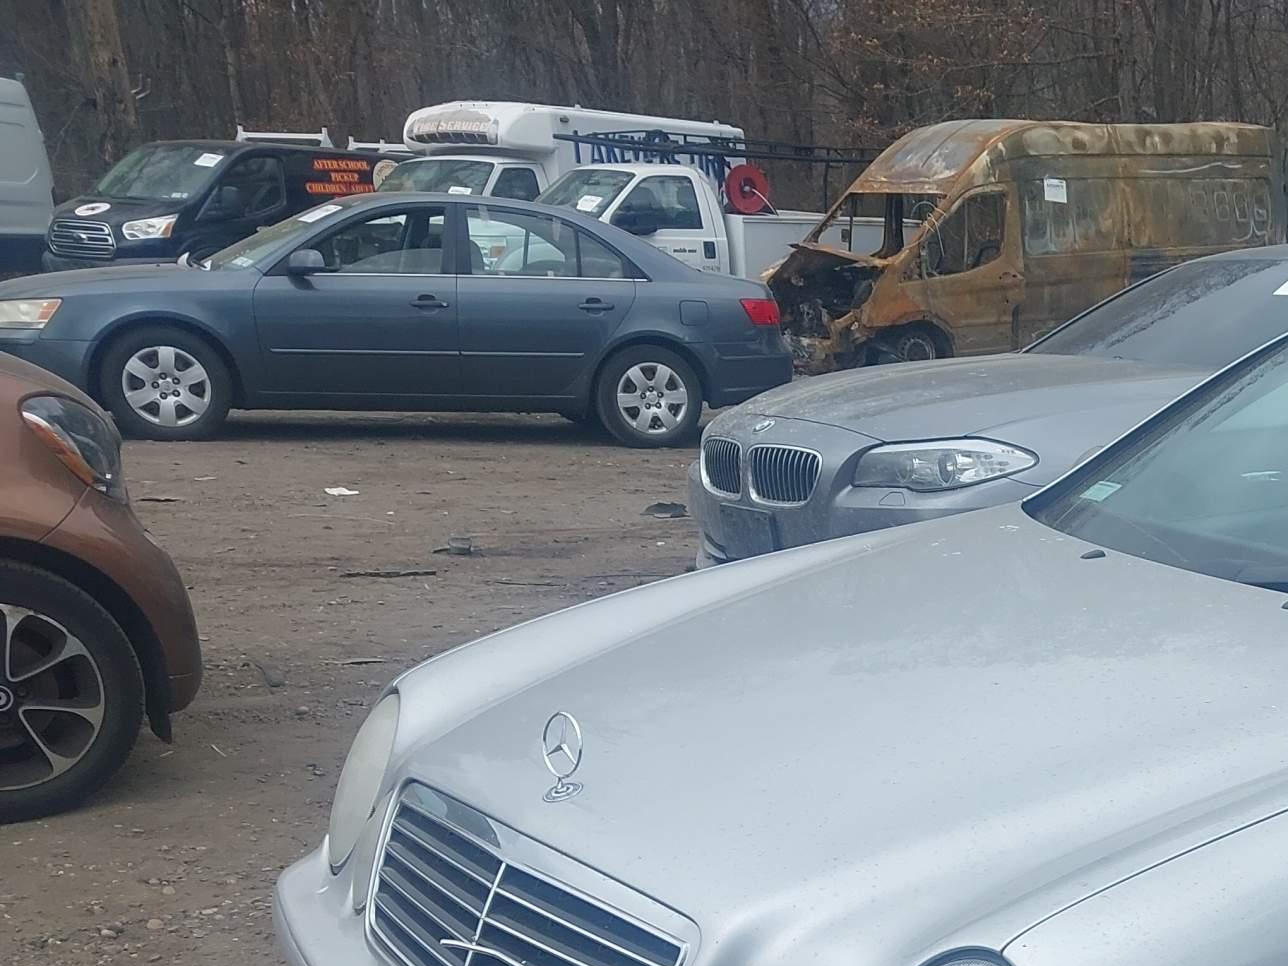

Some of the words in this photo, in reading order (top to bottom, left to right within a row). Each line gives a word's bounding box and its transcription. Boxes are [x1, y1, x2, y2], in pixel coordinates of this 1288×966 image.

[313, 160, 338, 169] AFTER
[338, 160, 369, 169] SCHOOL
[330, 173, 359, 182] PICKUP
[305, 182, 346, 193] CHILDREN
